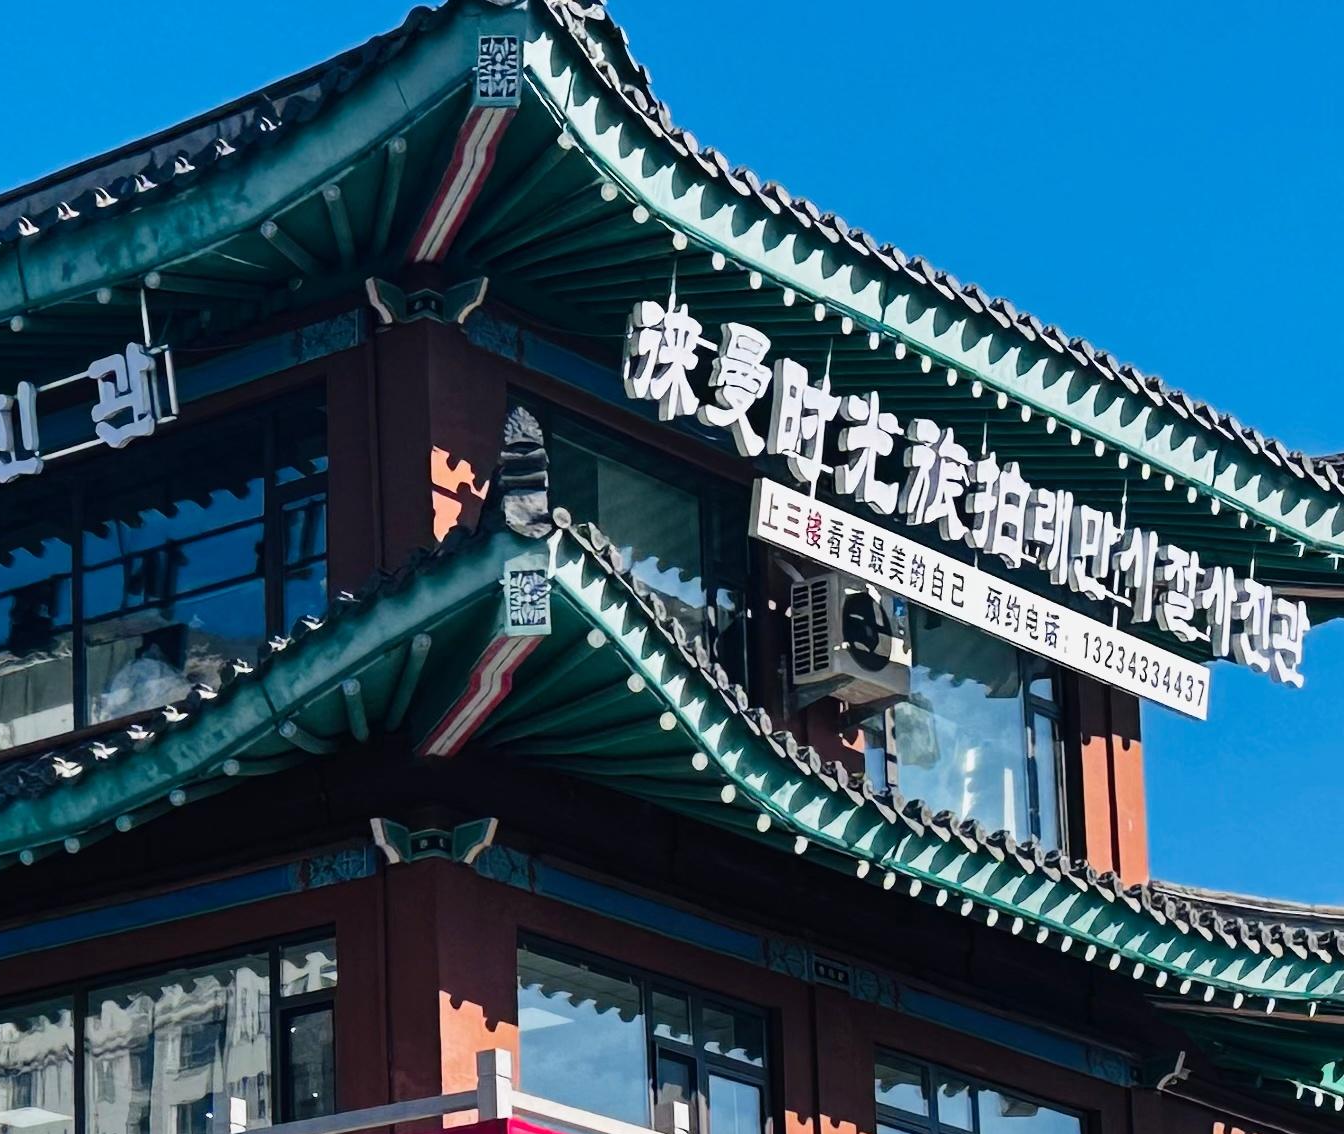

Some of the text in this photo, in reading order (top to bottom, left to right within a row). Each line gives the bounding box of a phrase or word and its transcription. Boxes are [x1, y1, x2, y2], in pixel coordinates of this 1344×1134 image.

[761, 492, 965, 608] 上三楼看看最美的自己
[1082, 631, 1205, 707] 13234334437
